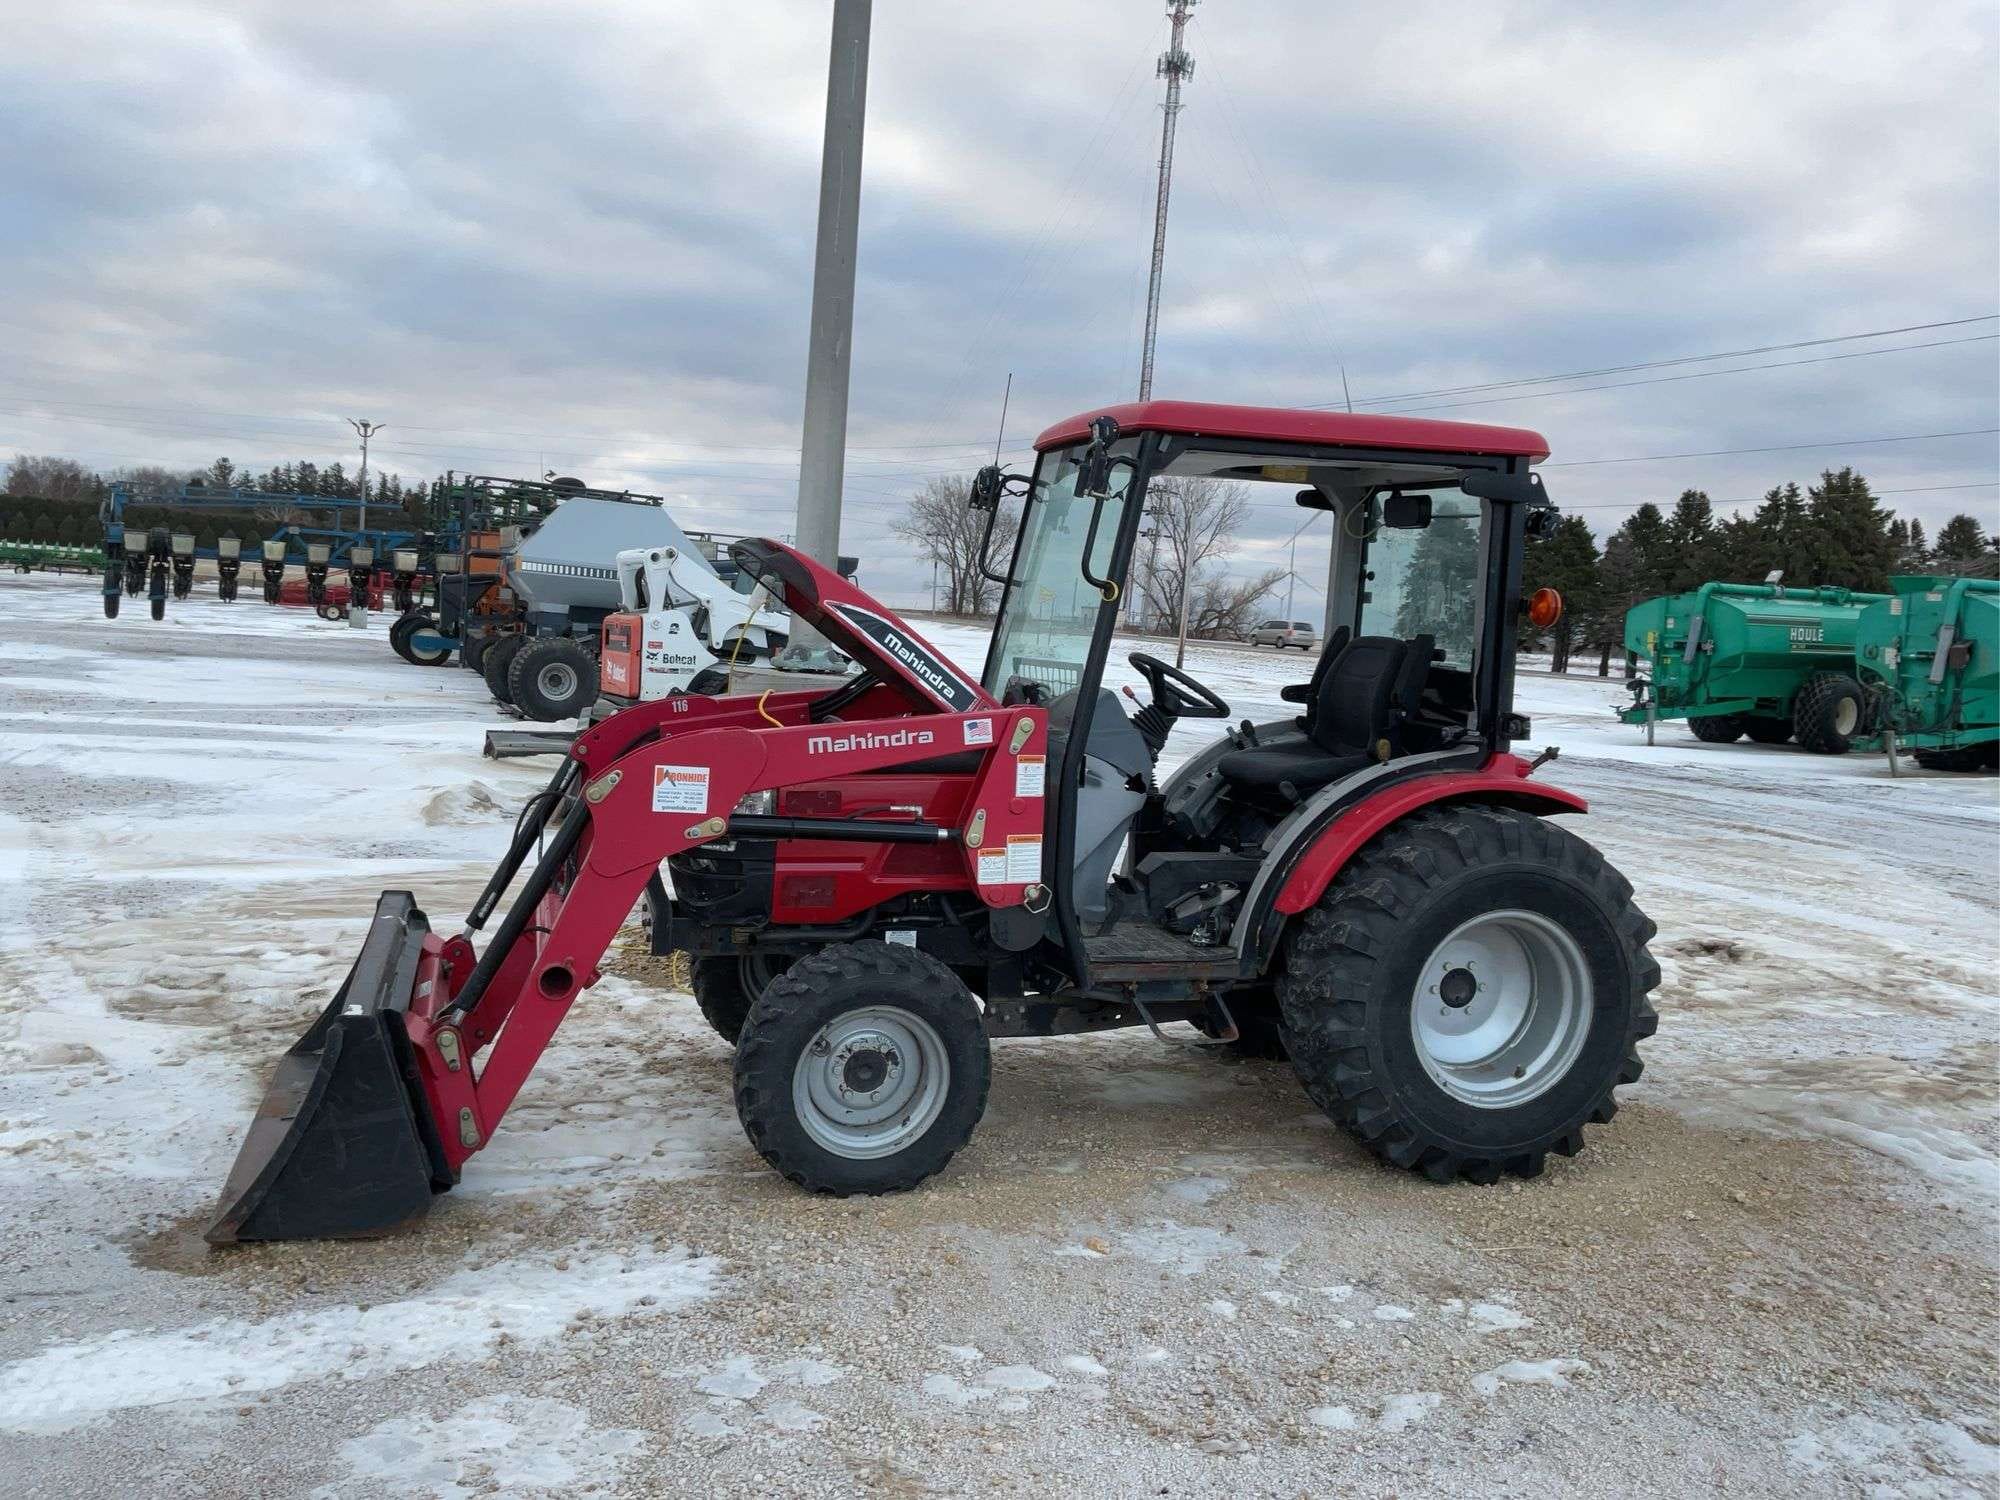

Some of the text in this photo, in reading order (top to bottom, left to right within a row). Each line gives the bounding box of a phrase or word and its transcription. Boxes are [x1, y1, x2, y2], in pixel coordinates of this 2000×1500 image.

[1790, 627, 1824, 642] HOULE
[662, 653, 697, 666] Bobcat
[883, 632, 956, 700] Mahindra
[671, 699, 689, 713] 116
[808, 729, 934, 755] Mahindra
